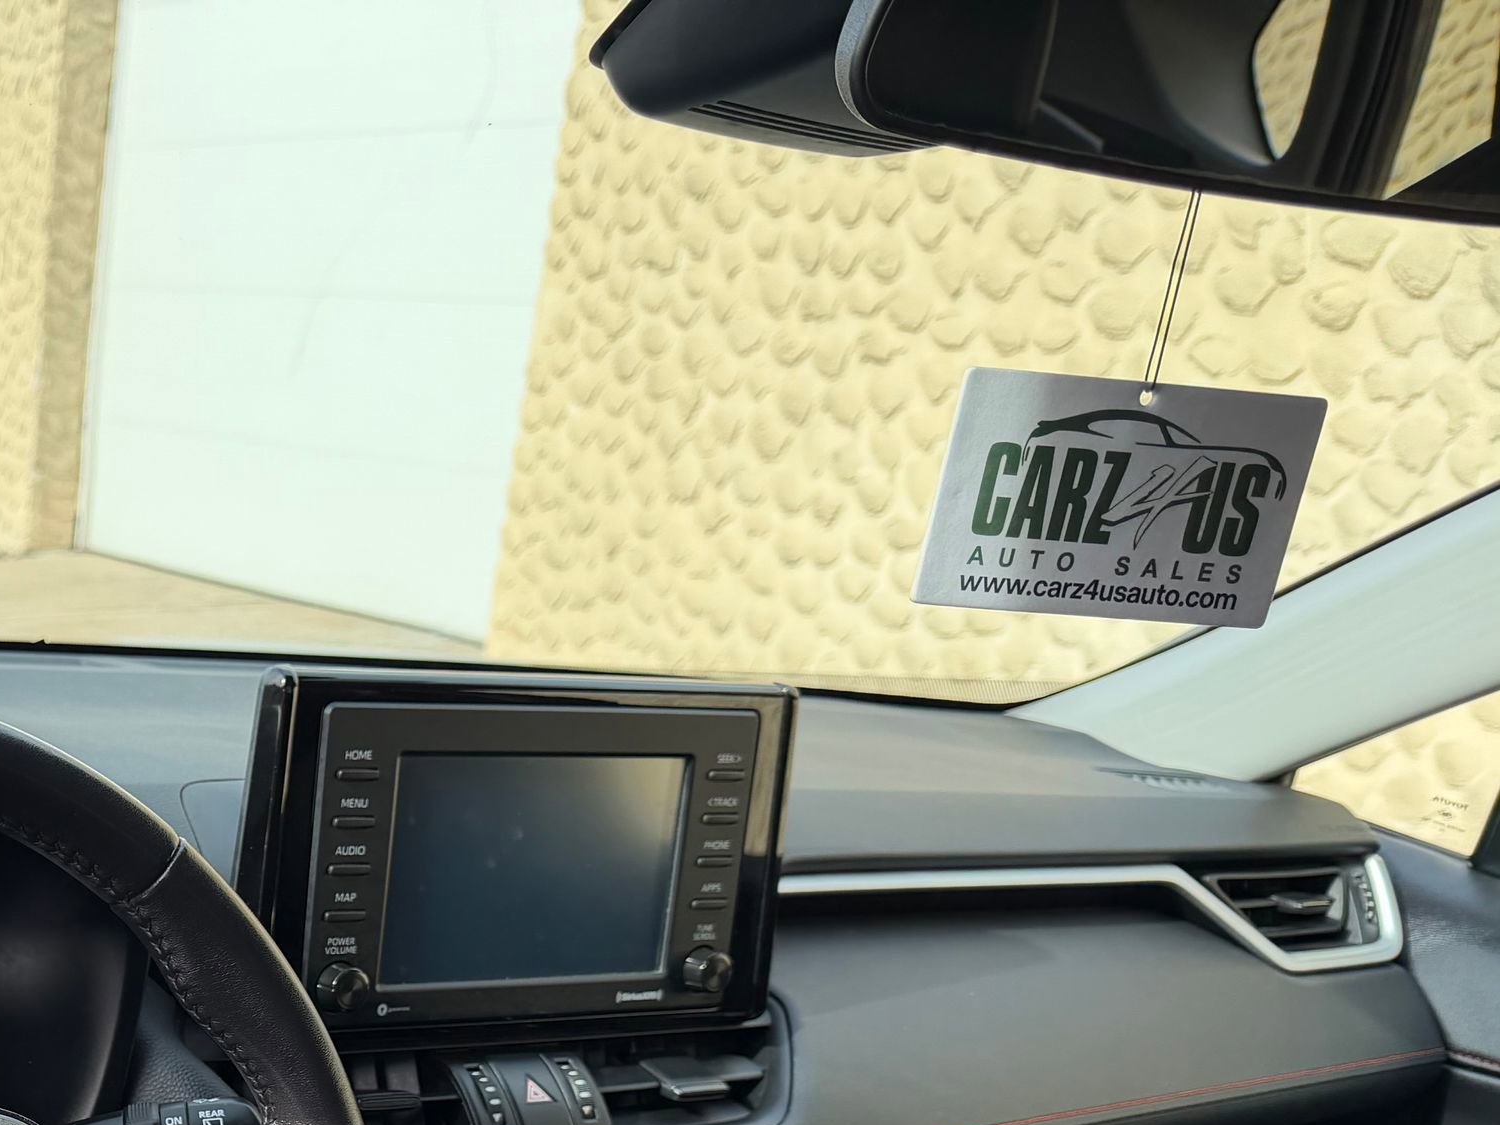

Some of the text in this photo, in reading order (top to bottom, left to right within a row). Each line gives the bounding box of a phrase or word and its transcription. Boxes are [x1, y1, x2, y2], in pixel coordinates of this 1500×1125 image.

[1181, 461, 1271, 557] US
[966, 545, 1243, 584] AUTO SALES
[959, 573, 1238, 611] www.carz4usauto.com
[345, 750, 373, 760] HOME
[340, 798, 369, 809] MENU
[335, 845, 366, 856] AUDIO
[334, 892, 357, 903] MAP
[327, 937, 355, 946] POWER
[325, 946, 358, 955] VOLUME
[198, 1109, 226, 1118] REAR
[165, 1116, 183, 1125] ON
